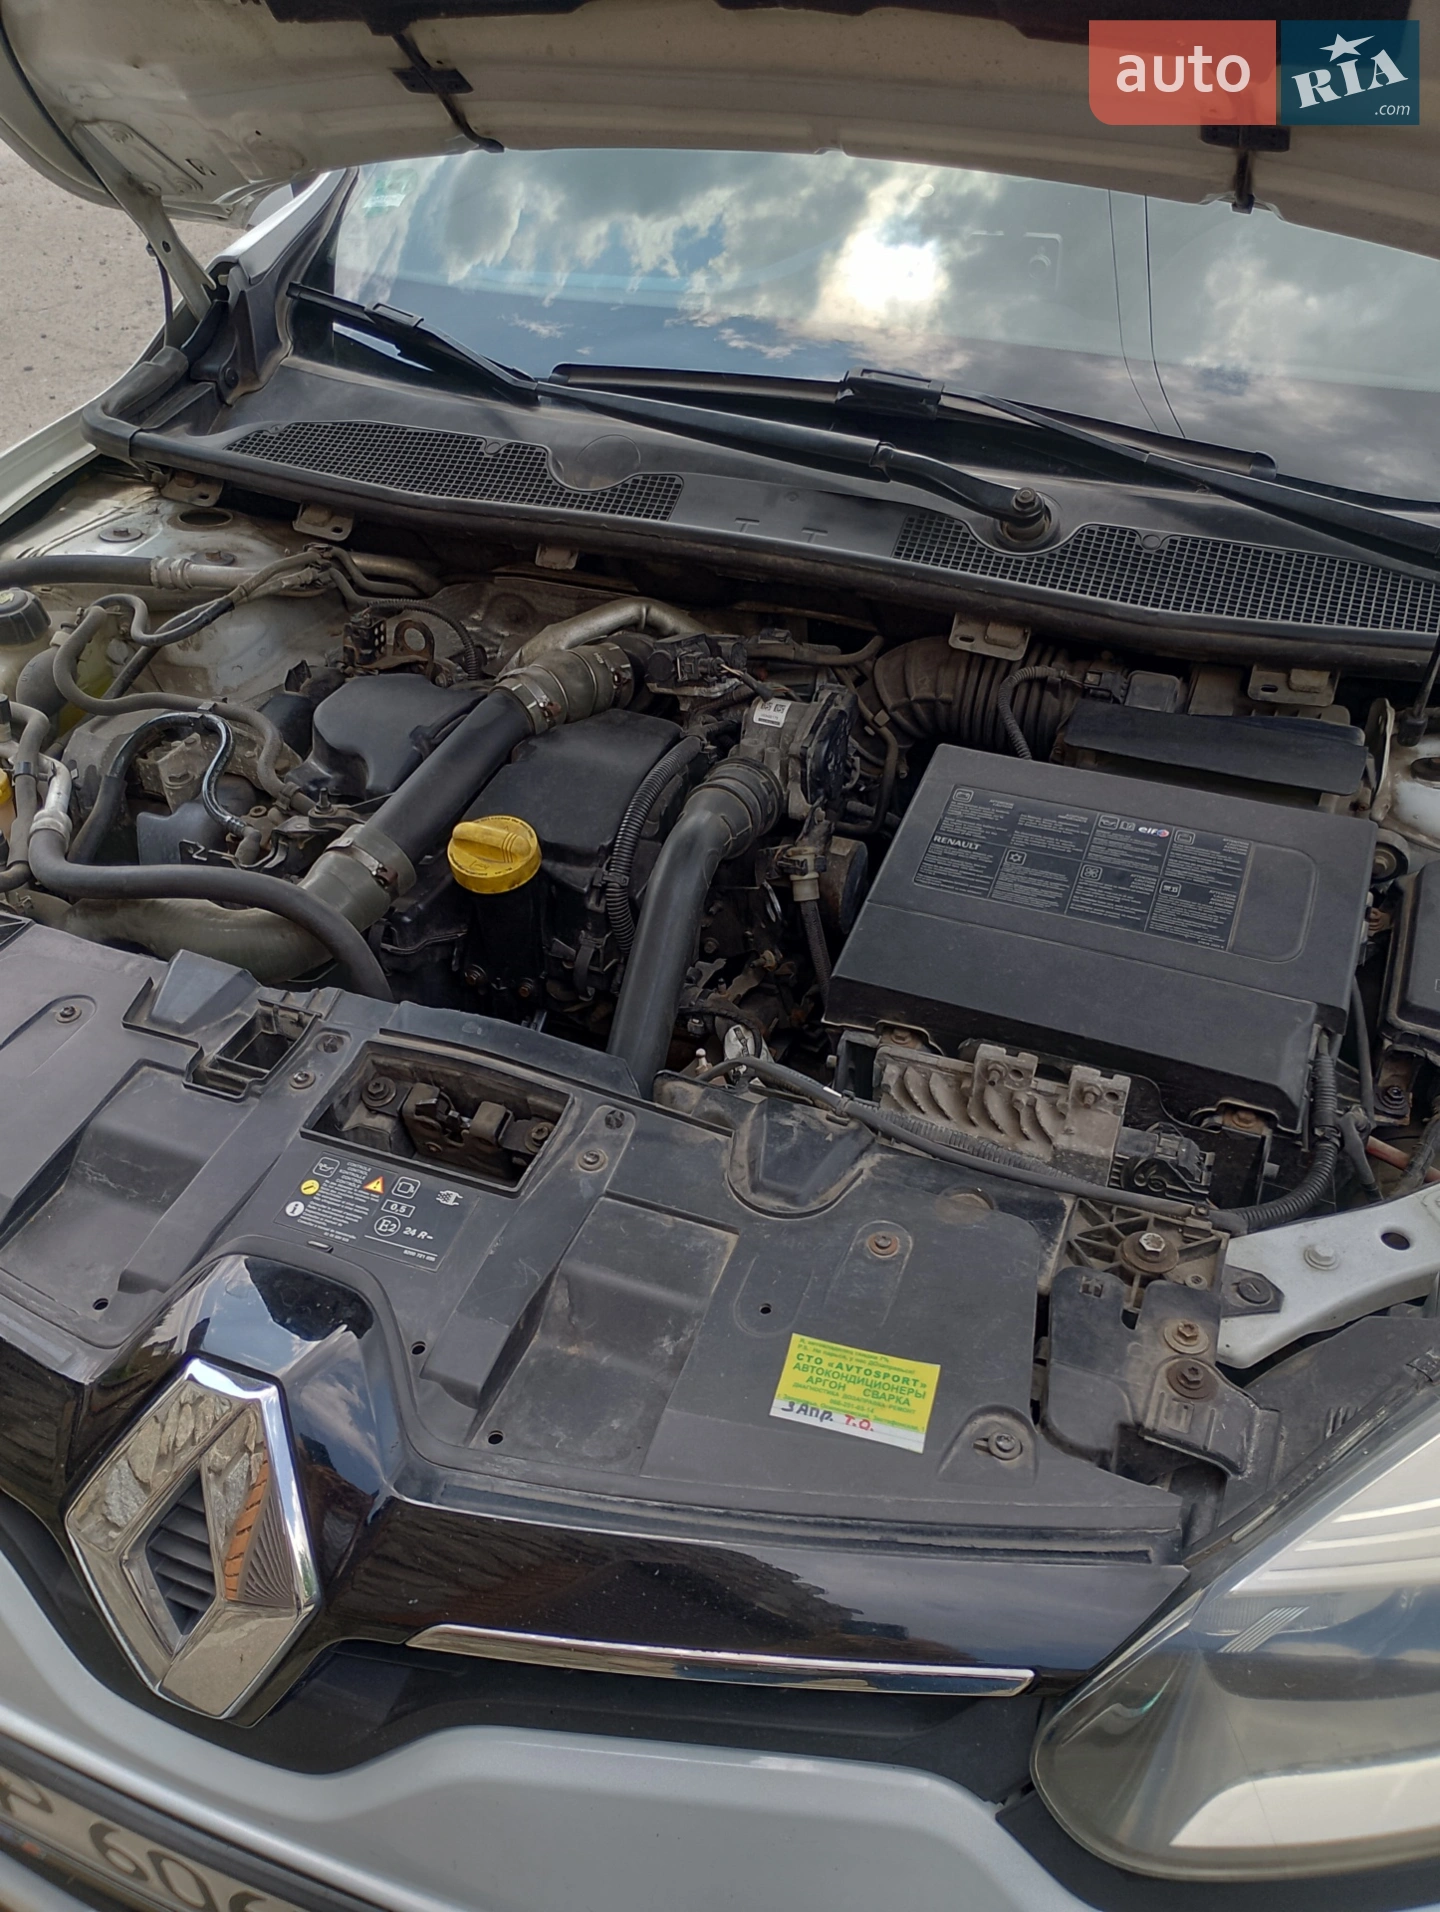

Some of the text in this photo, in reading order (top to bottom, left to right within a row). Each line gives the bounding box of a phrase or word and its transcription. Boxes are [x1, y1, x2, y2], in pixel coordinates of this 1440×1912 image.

[1138, 826, 1158, 835] elf
[933, 835, 981, 850] RENAULT
[390, 1203, 407, 1213] 0,5
[377, 1219, 397, 1232] E2
[796, 1353, 927, 1389] СТО «AVTOSPORT»
[793, 1362, 926, 1399] АВТОКОНДИЦИОНЕРЫ
[792, 1382, 839, 1397] ДИАГНОСТИКА
[806, 1375, 910, 1406] АРГОН СВАРКА
